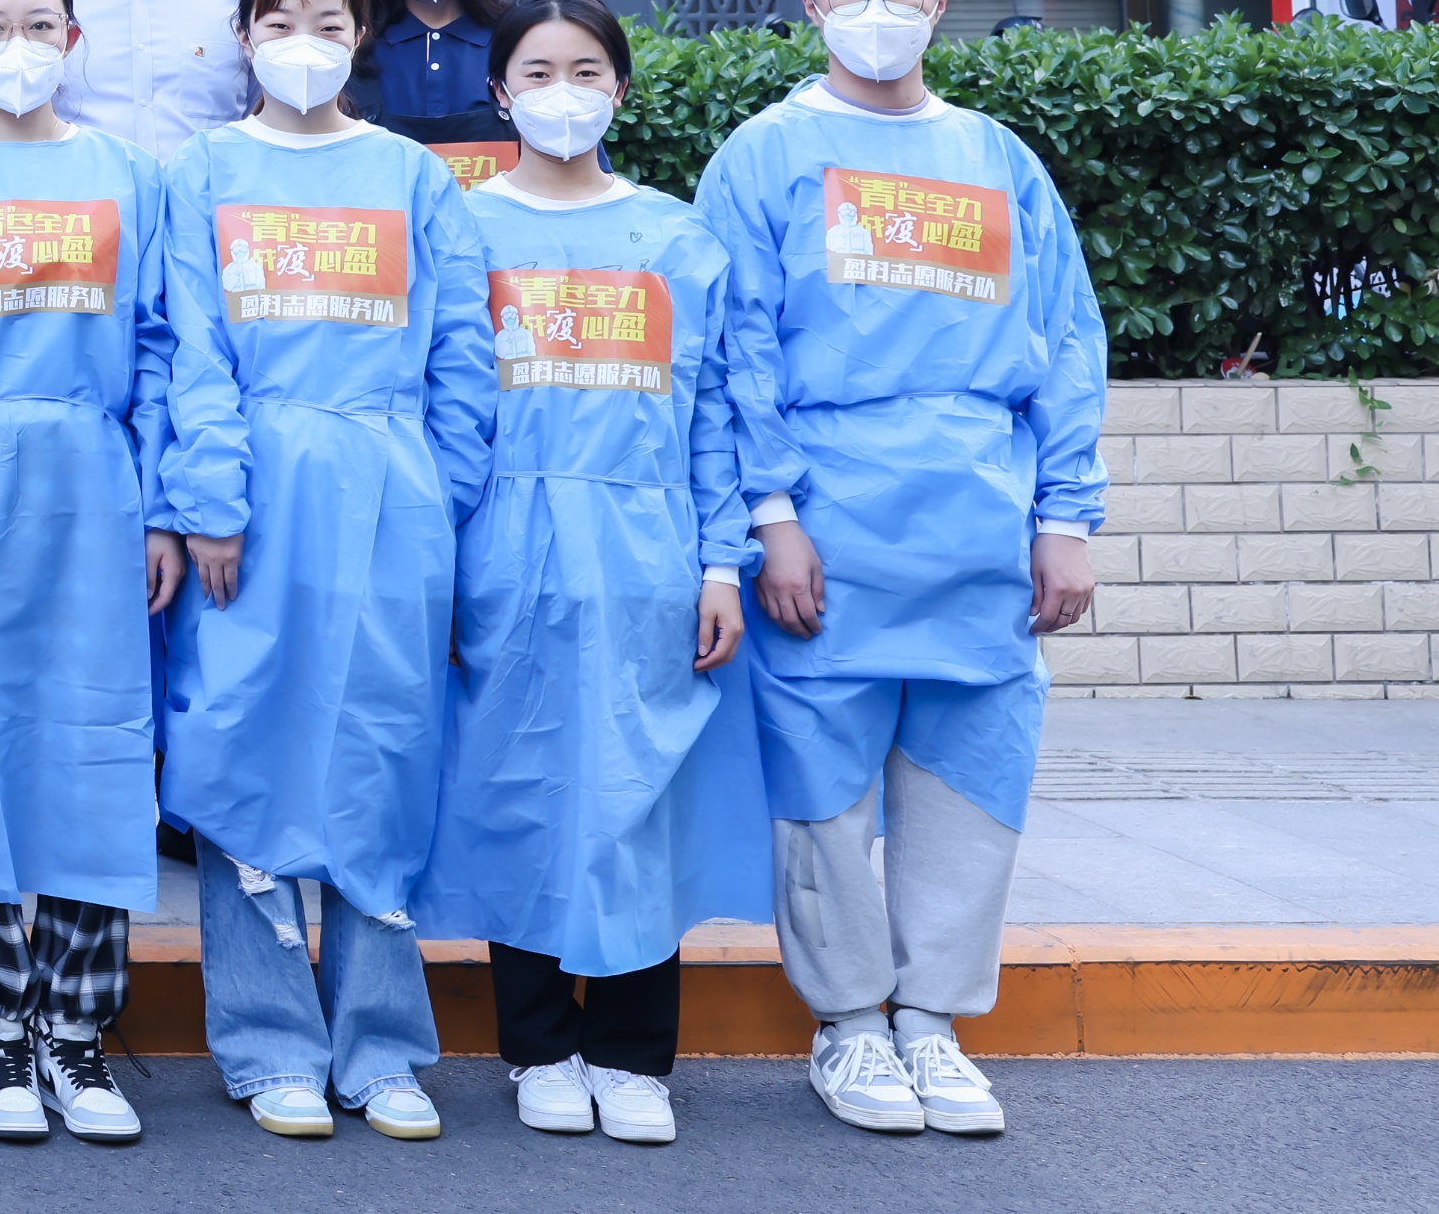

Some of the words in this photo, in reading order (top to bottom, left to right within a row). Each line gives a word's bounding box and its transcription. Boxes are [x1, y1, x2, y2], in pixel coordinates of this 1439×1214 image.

[842, 258, 996, 300] 盈科志愿服务队
[240, 294, 394, 323] 盈科志愿服务队
[511, 360, 661, 390] 盈科志愿服务队
